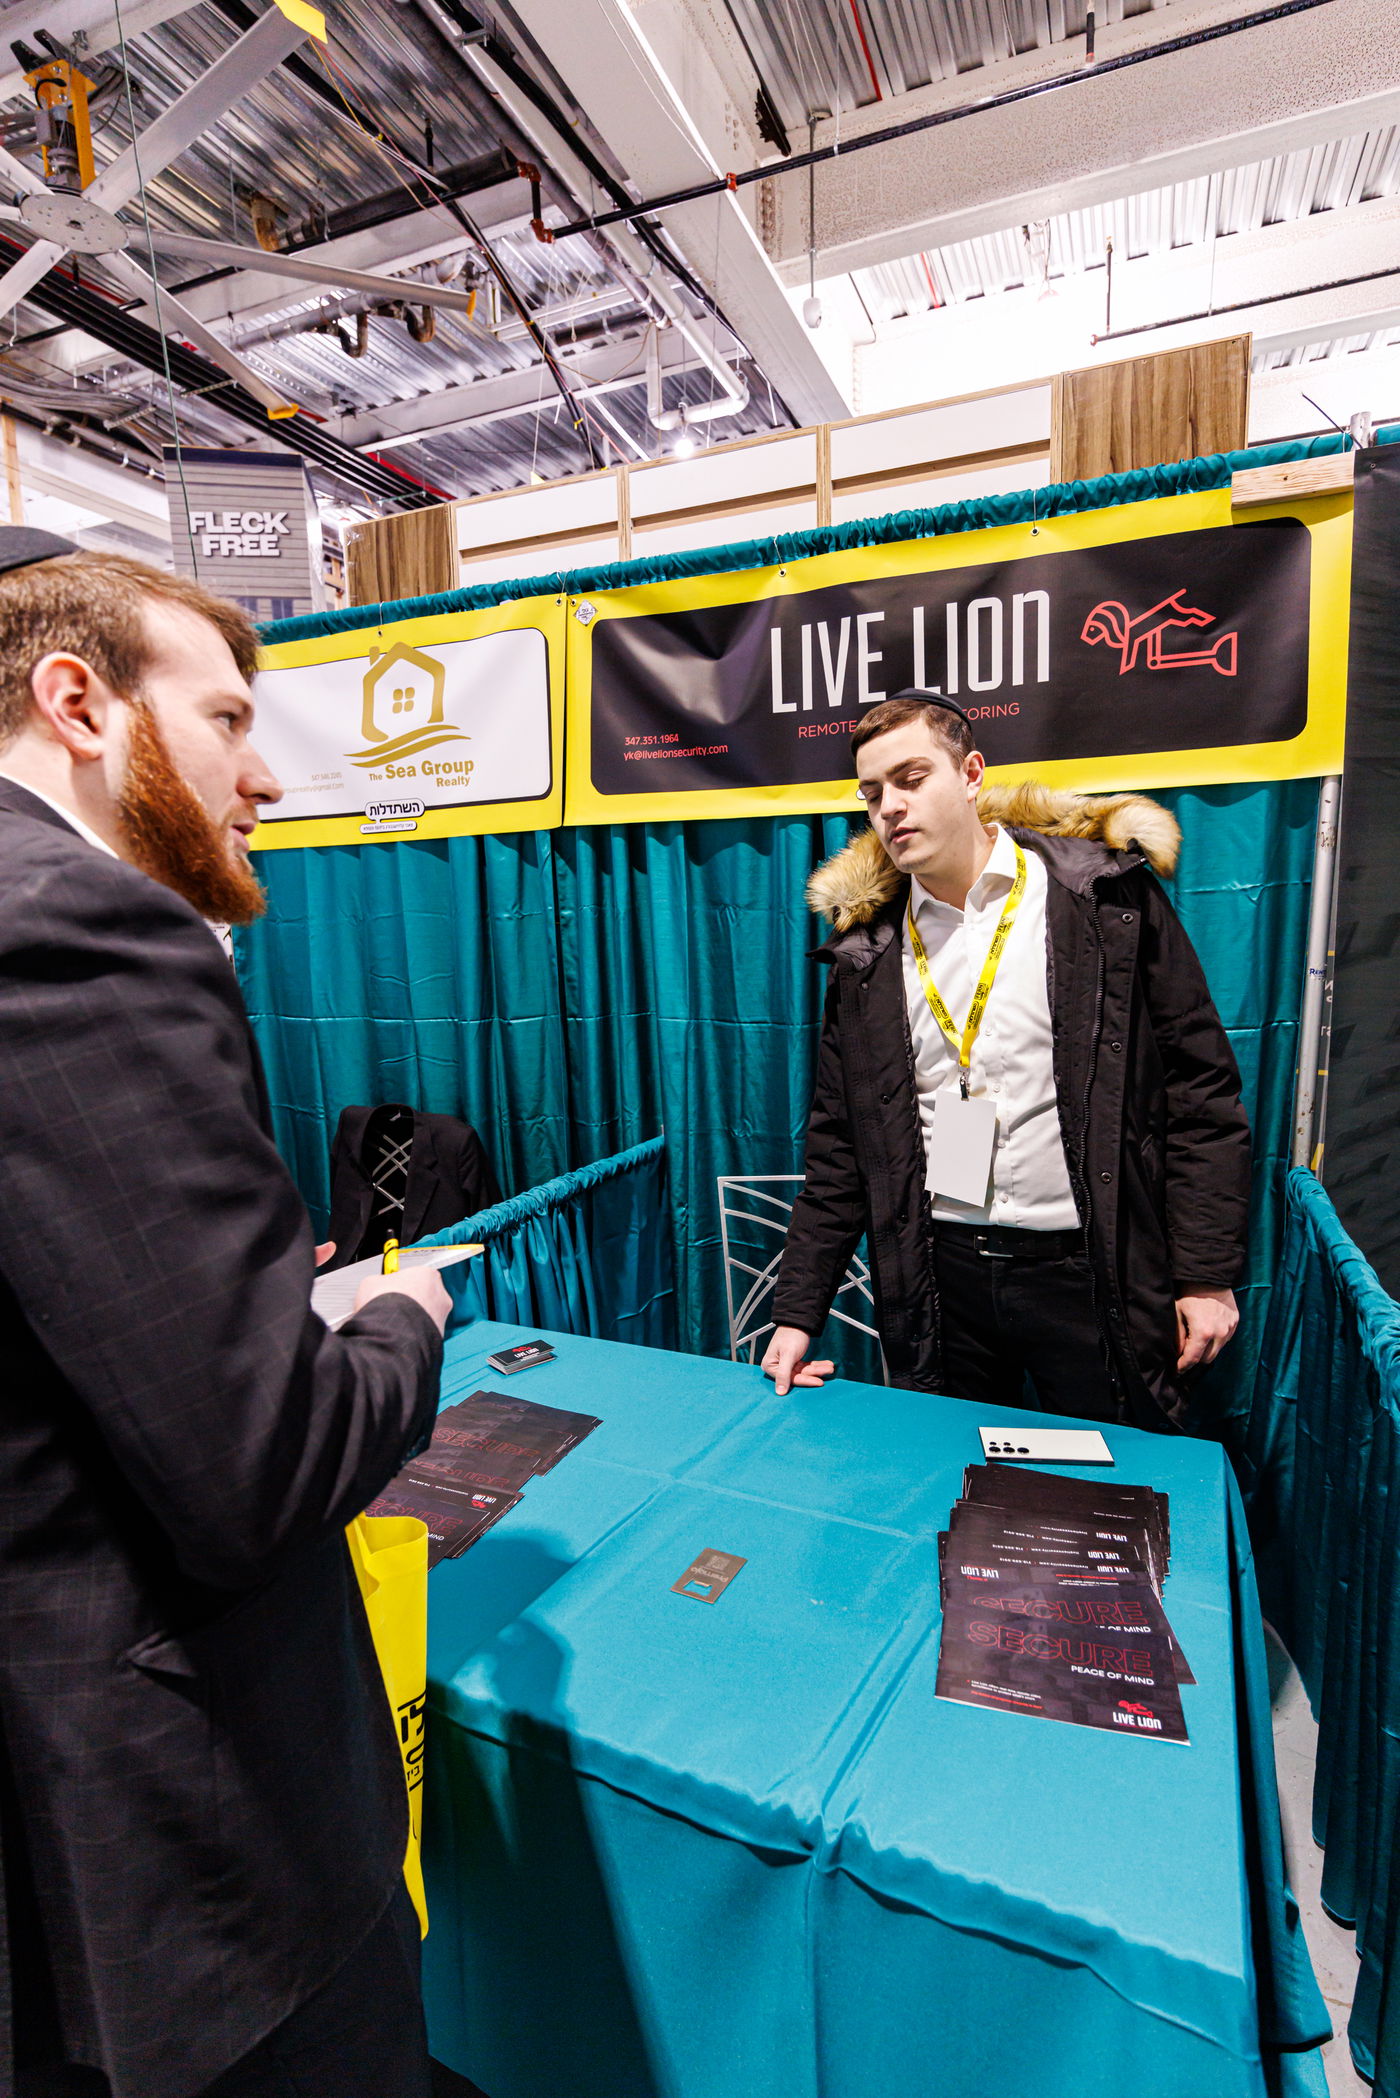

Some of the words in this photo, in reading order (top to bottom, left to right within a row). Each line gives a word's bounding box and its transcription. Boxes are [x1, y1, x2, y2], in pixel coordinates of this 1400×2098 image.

[189, 511, 290, 535] FLECK
[201, 534, 281, 557] FREE
[770, 611, 887, 714] LIVE
[913, 590, 1050, 695] LION
[798, 719, 858, 738] REMOTE
[624, 733, 679, 746] 347.351.1964
[623, 744, 729, 761] yk@livelionsecurity.com
[369, 773, 383, 781] The
[385, 764, 417, 780] Sea
[421, 759, 475, 776] Group
[436, 776, 471, 788] Realty
[369, 802, 420, 816] השתדלות
[1113, 1533, 1128, 1543] LIVE
[1087, 1551, 1105, 1560] LION
[1105, 1552, 1120, 1561] LIVE
[960, 1566, 981, 1577] LION
[981, 1569, 1000, 1579] LIVE
[1114, 1566, 1130, 1574] LIVE
[967, 1620, 1154, 1677] SECURE
[1071, 1665, 1105, 1678] PEACE
[1107, 1671, 1122, 1680] OF
[1124, 1674, 1155, 1686] MIND
[1113, 1711, 1136, 1727] LIVE
[1137, 1716, 1162, 1730] LION
